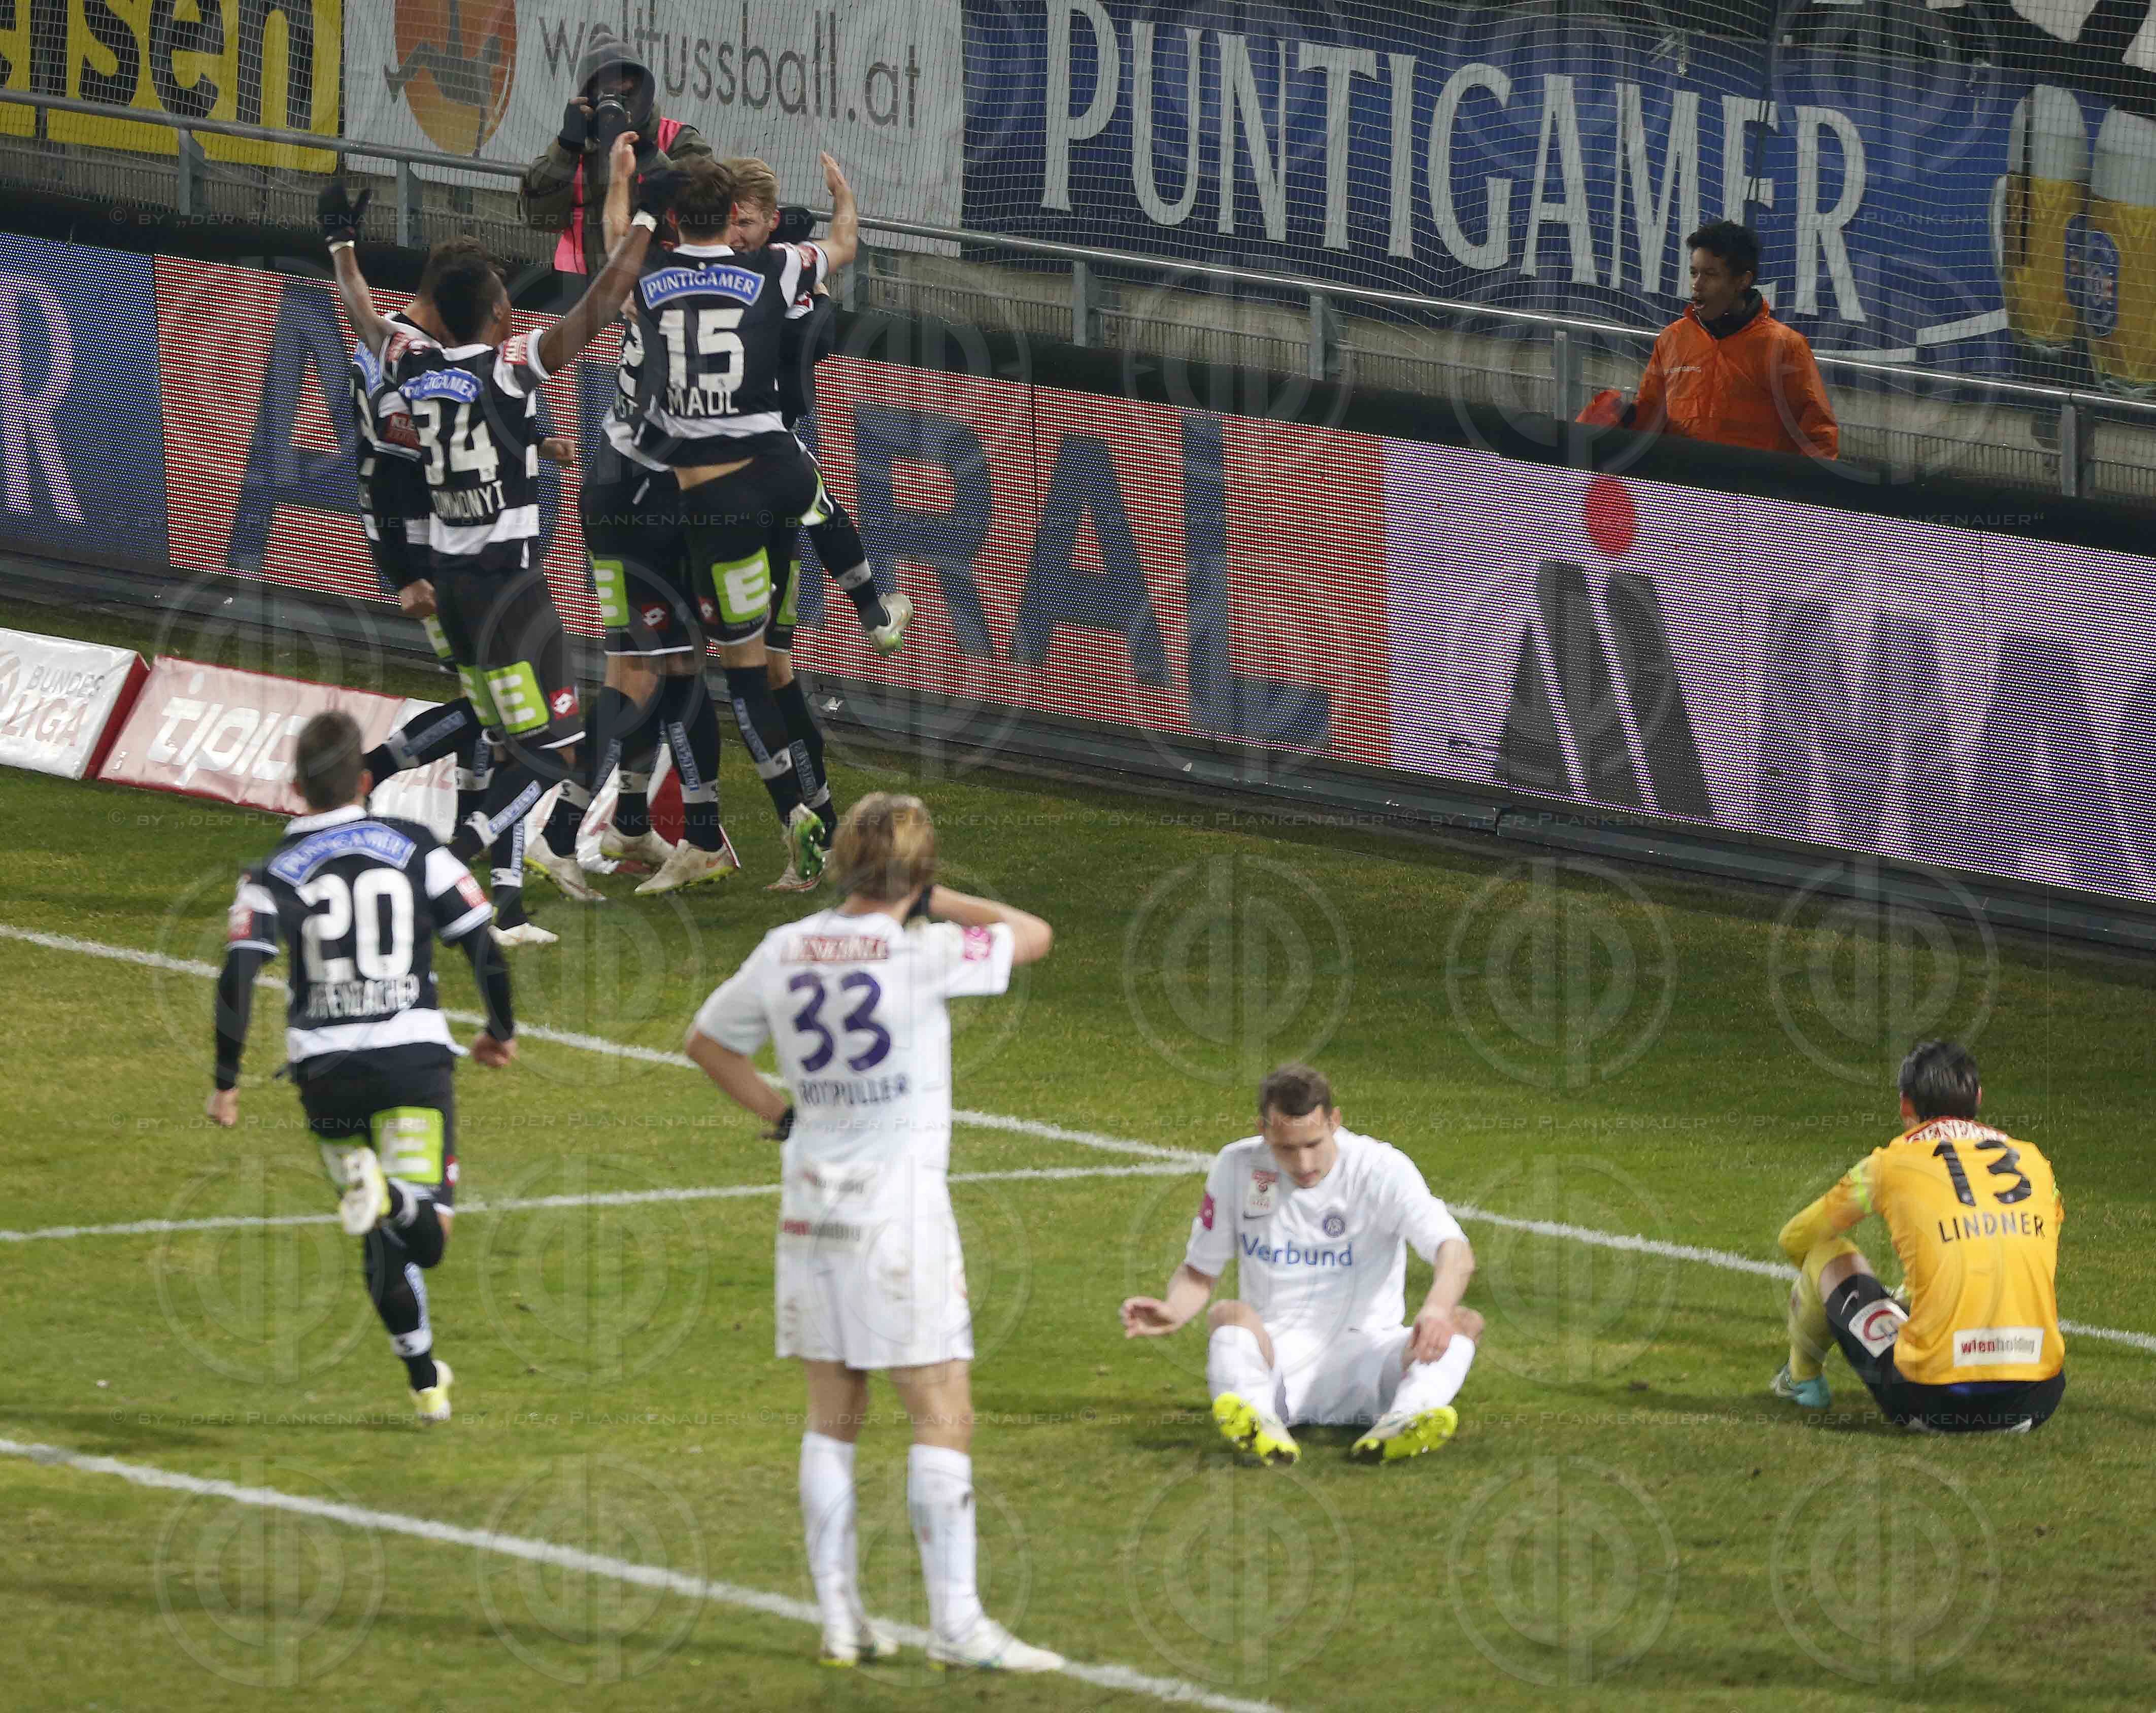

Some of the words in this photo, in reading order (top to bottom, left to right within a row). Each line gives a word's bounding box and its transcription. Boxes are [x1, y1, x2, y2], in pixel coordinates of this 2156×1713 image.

[646, 269, 755, 298] PUNTIGAMER
[659, 309, 746, 392] 15
[412, 400, 499, 486] 34
[146, 673, 306, 786] tipic
[297, 868, 414, 985] 20
[789, 972, 890, 1072] 33
[1933, 1140, 2032, 1207] 13
[1242, 1233, 1353, 1266] Verbund
[1937, 1213, 2045, 1243] LINDNER
